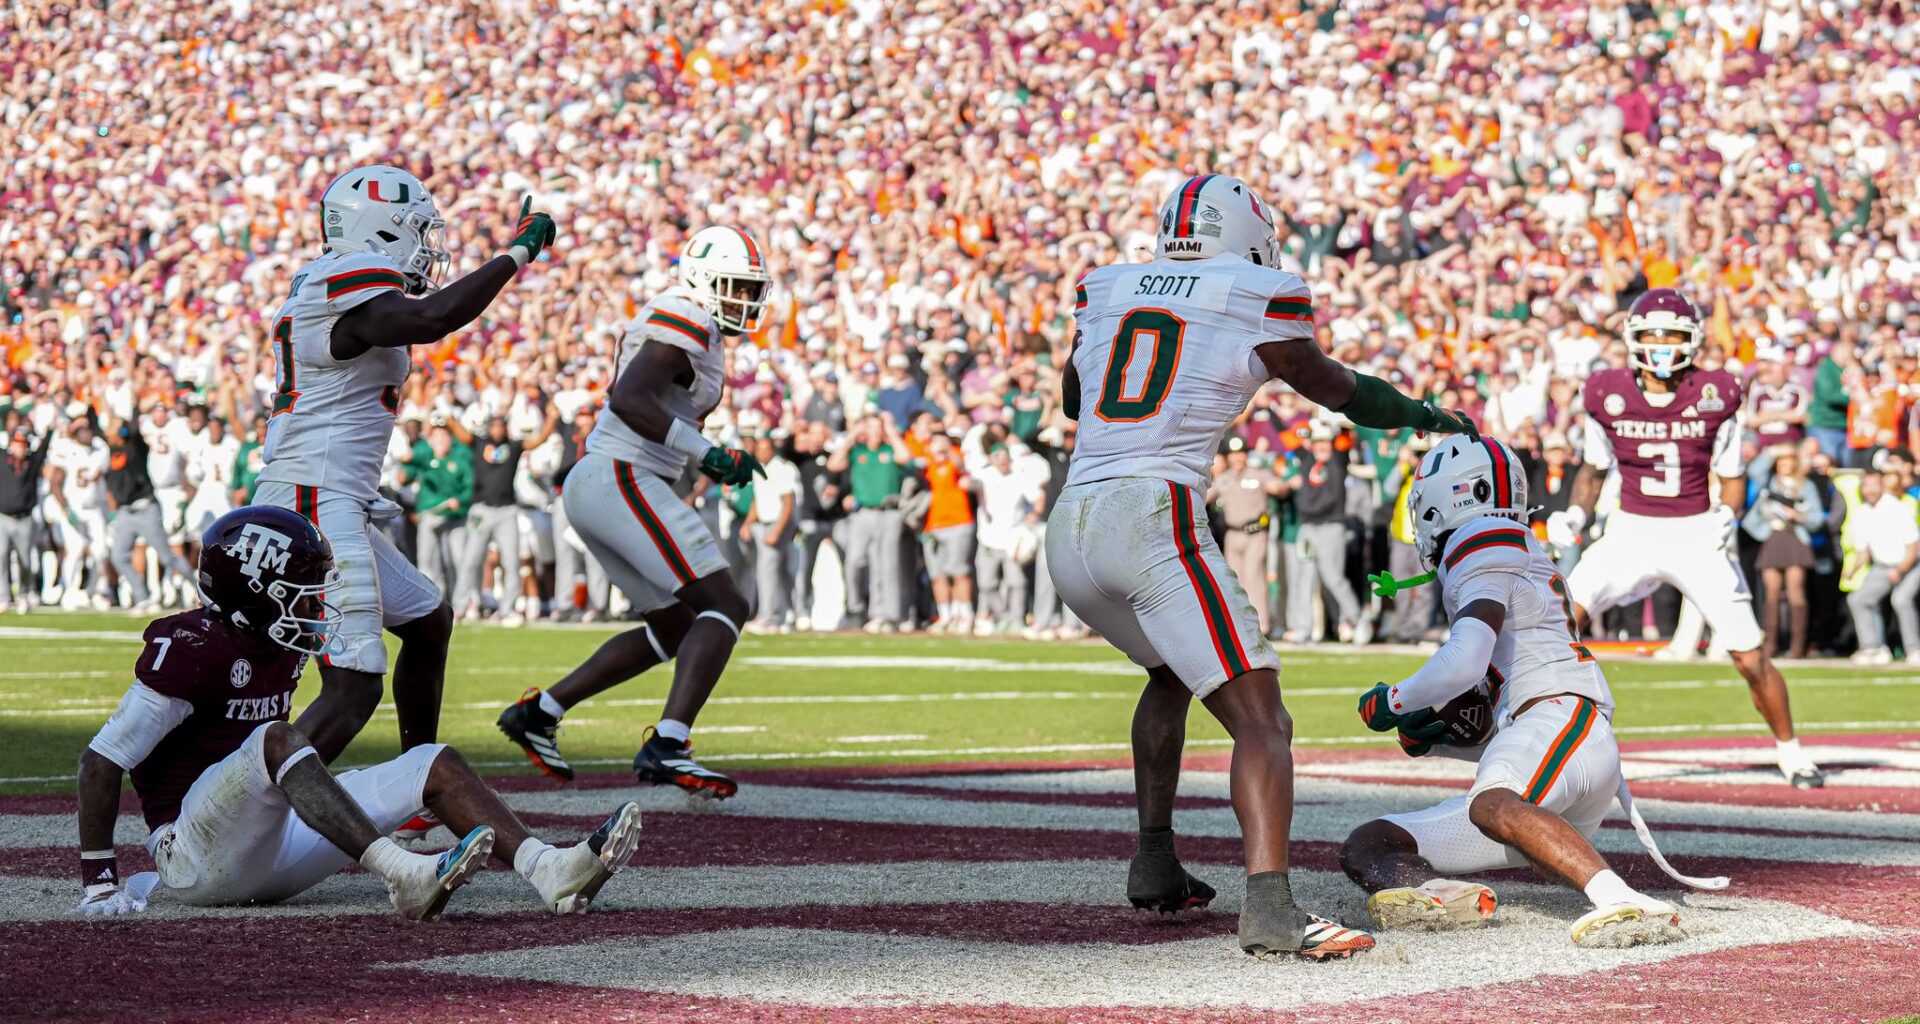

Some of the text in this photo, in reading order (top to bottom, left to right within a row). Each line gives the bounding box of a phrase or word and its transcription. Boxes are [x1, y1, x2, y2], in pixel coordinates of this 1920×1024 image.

[367, 180, 409, 203] U
[687, 239, 713, 258] U
[1164, 241, 1202, 253] MIAMI
[1134, 274, 1200, 298] SCOTT
[1094, 306, 1187, 423] 0
[1611, 419, 1706, 439] TEXAS A&M
[1637, 441, 1681, 497] 3
[152, 637, 172, 671] 7
[231, 661, 250, 686] SEC
[226, 694, 279, 720] TEXAS
